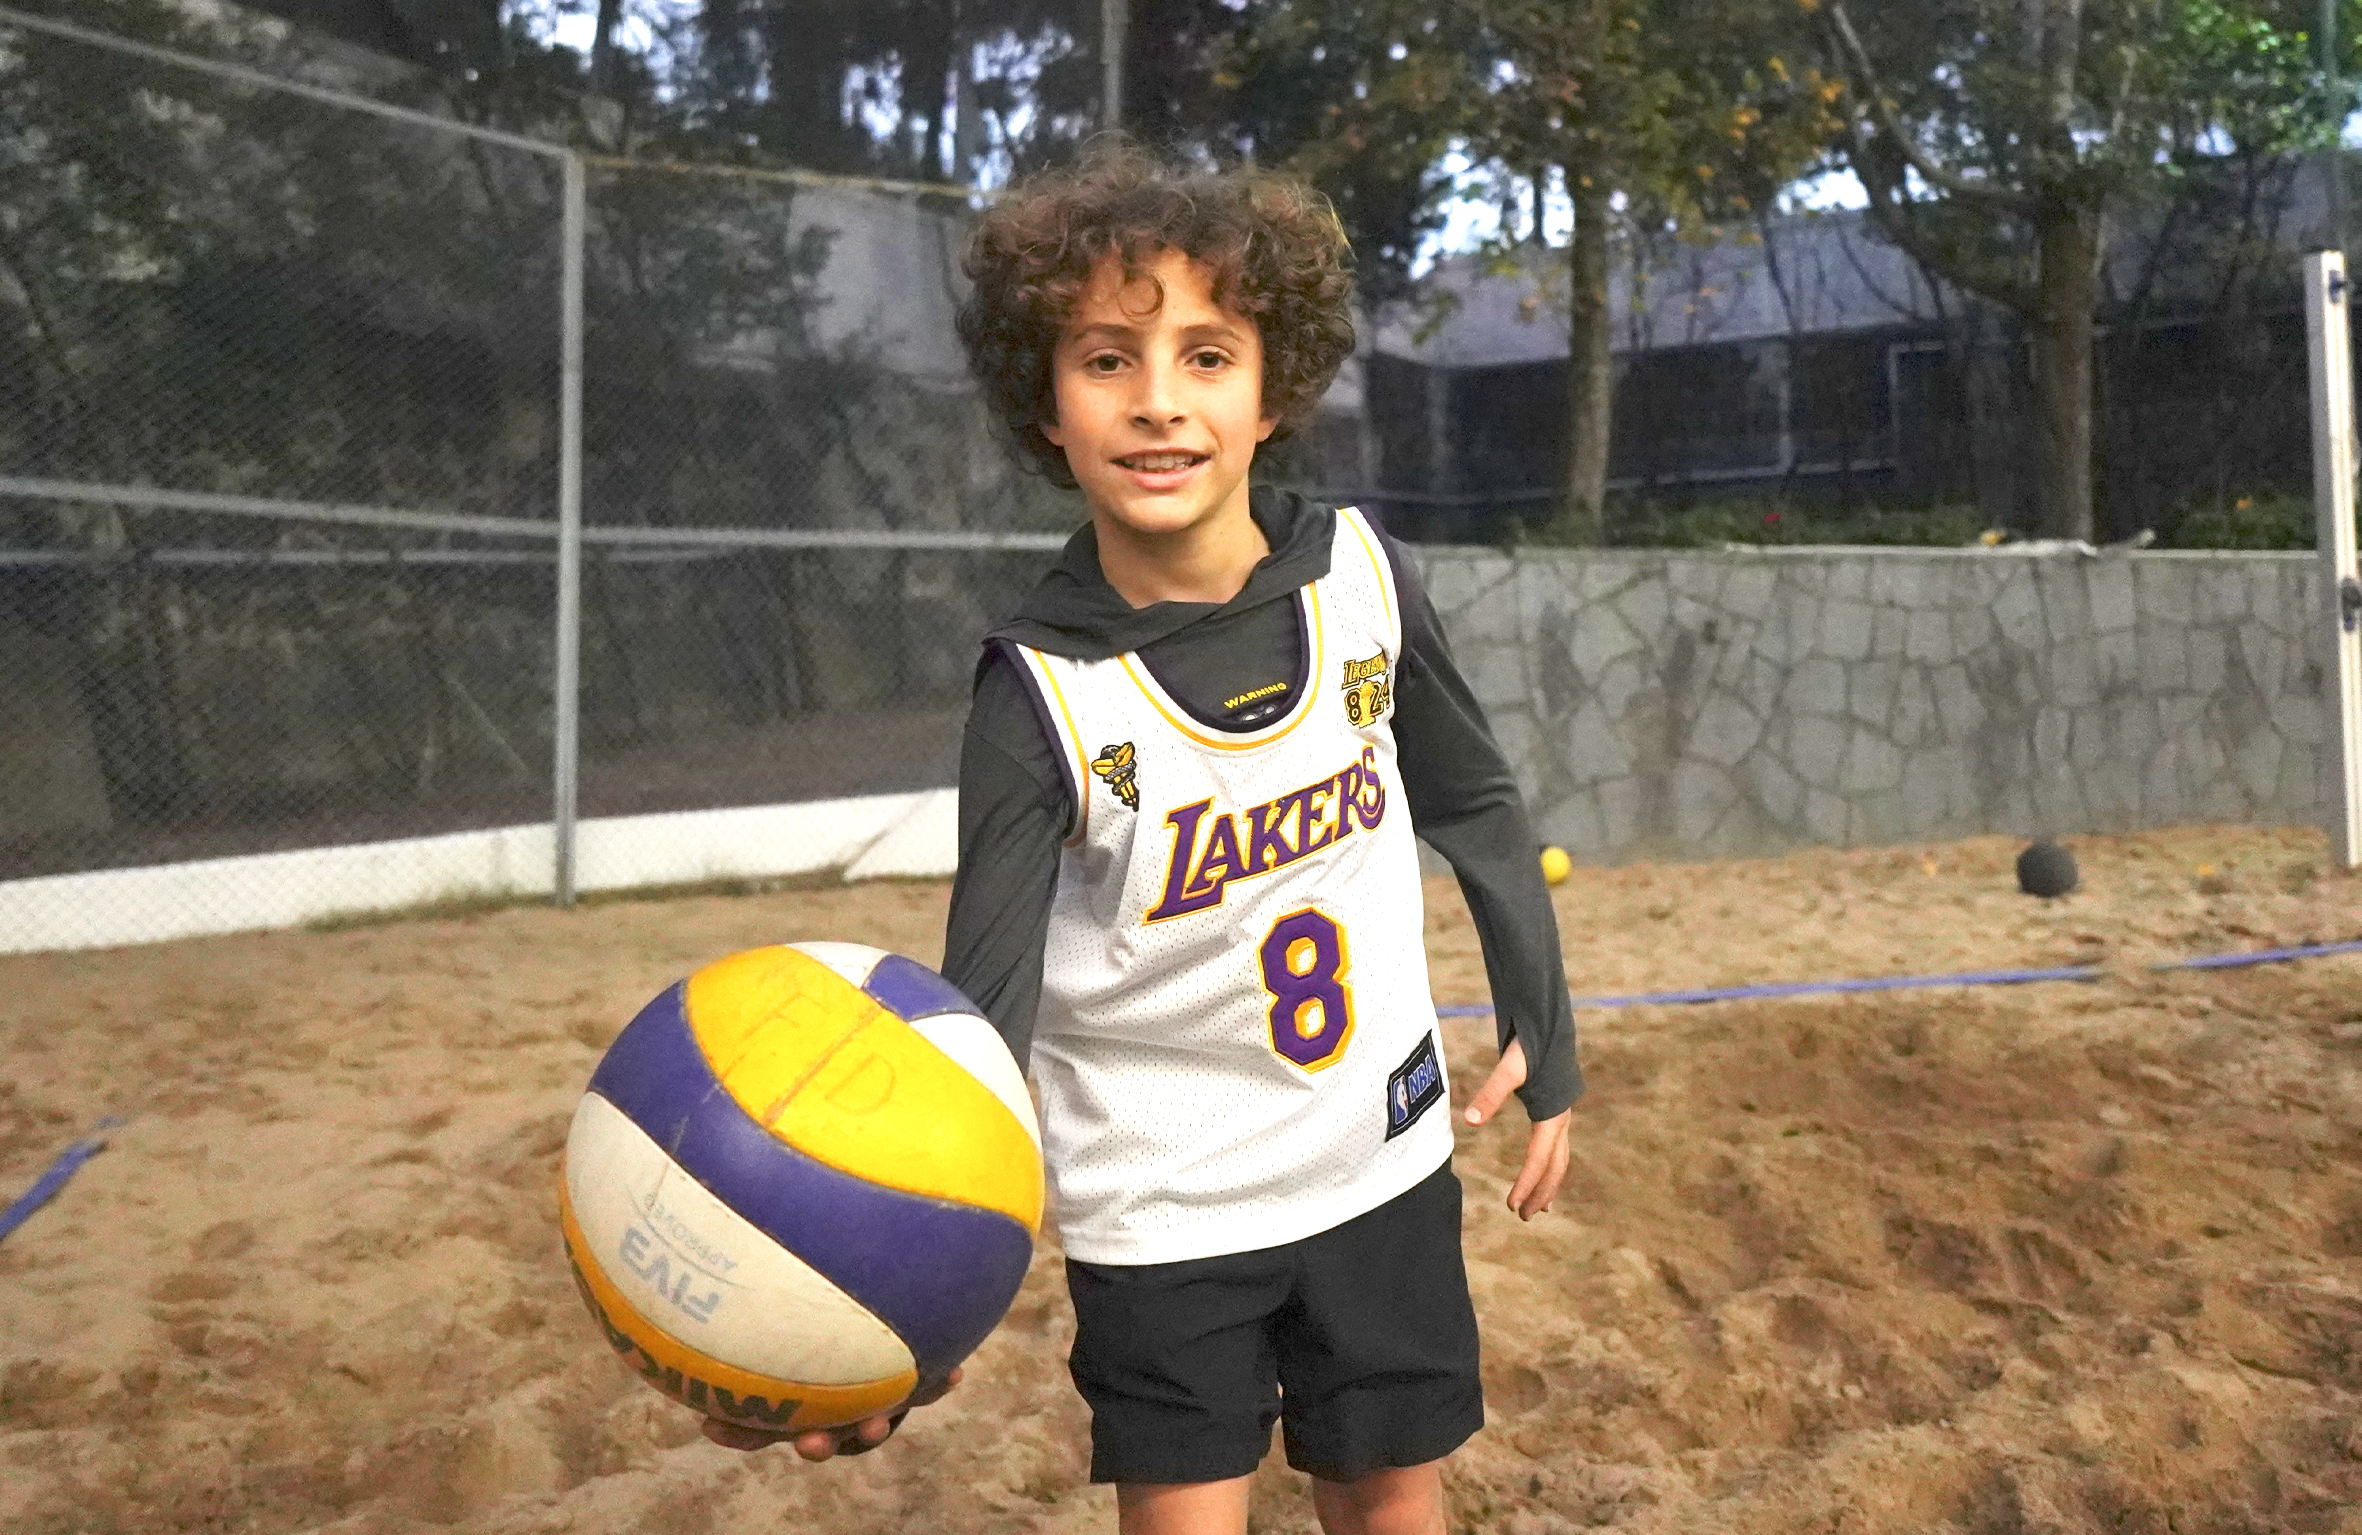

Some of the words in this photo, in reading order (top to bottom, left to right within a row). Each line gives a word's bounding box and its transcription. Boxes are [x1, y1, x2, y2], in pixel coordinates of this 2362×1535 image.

[1224, 682, 1287, 709] WARNING
[1344, 687, 1362, 726] 8
[1369, 680, 1391, 717] 24
[1142, 744, 1386, 927] LAKERS
[1256, 907, 1357, 1075] 8
[1408, 1053, 1436, 1104] NBA
